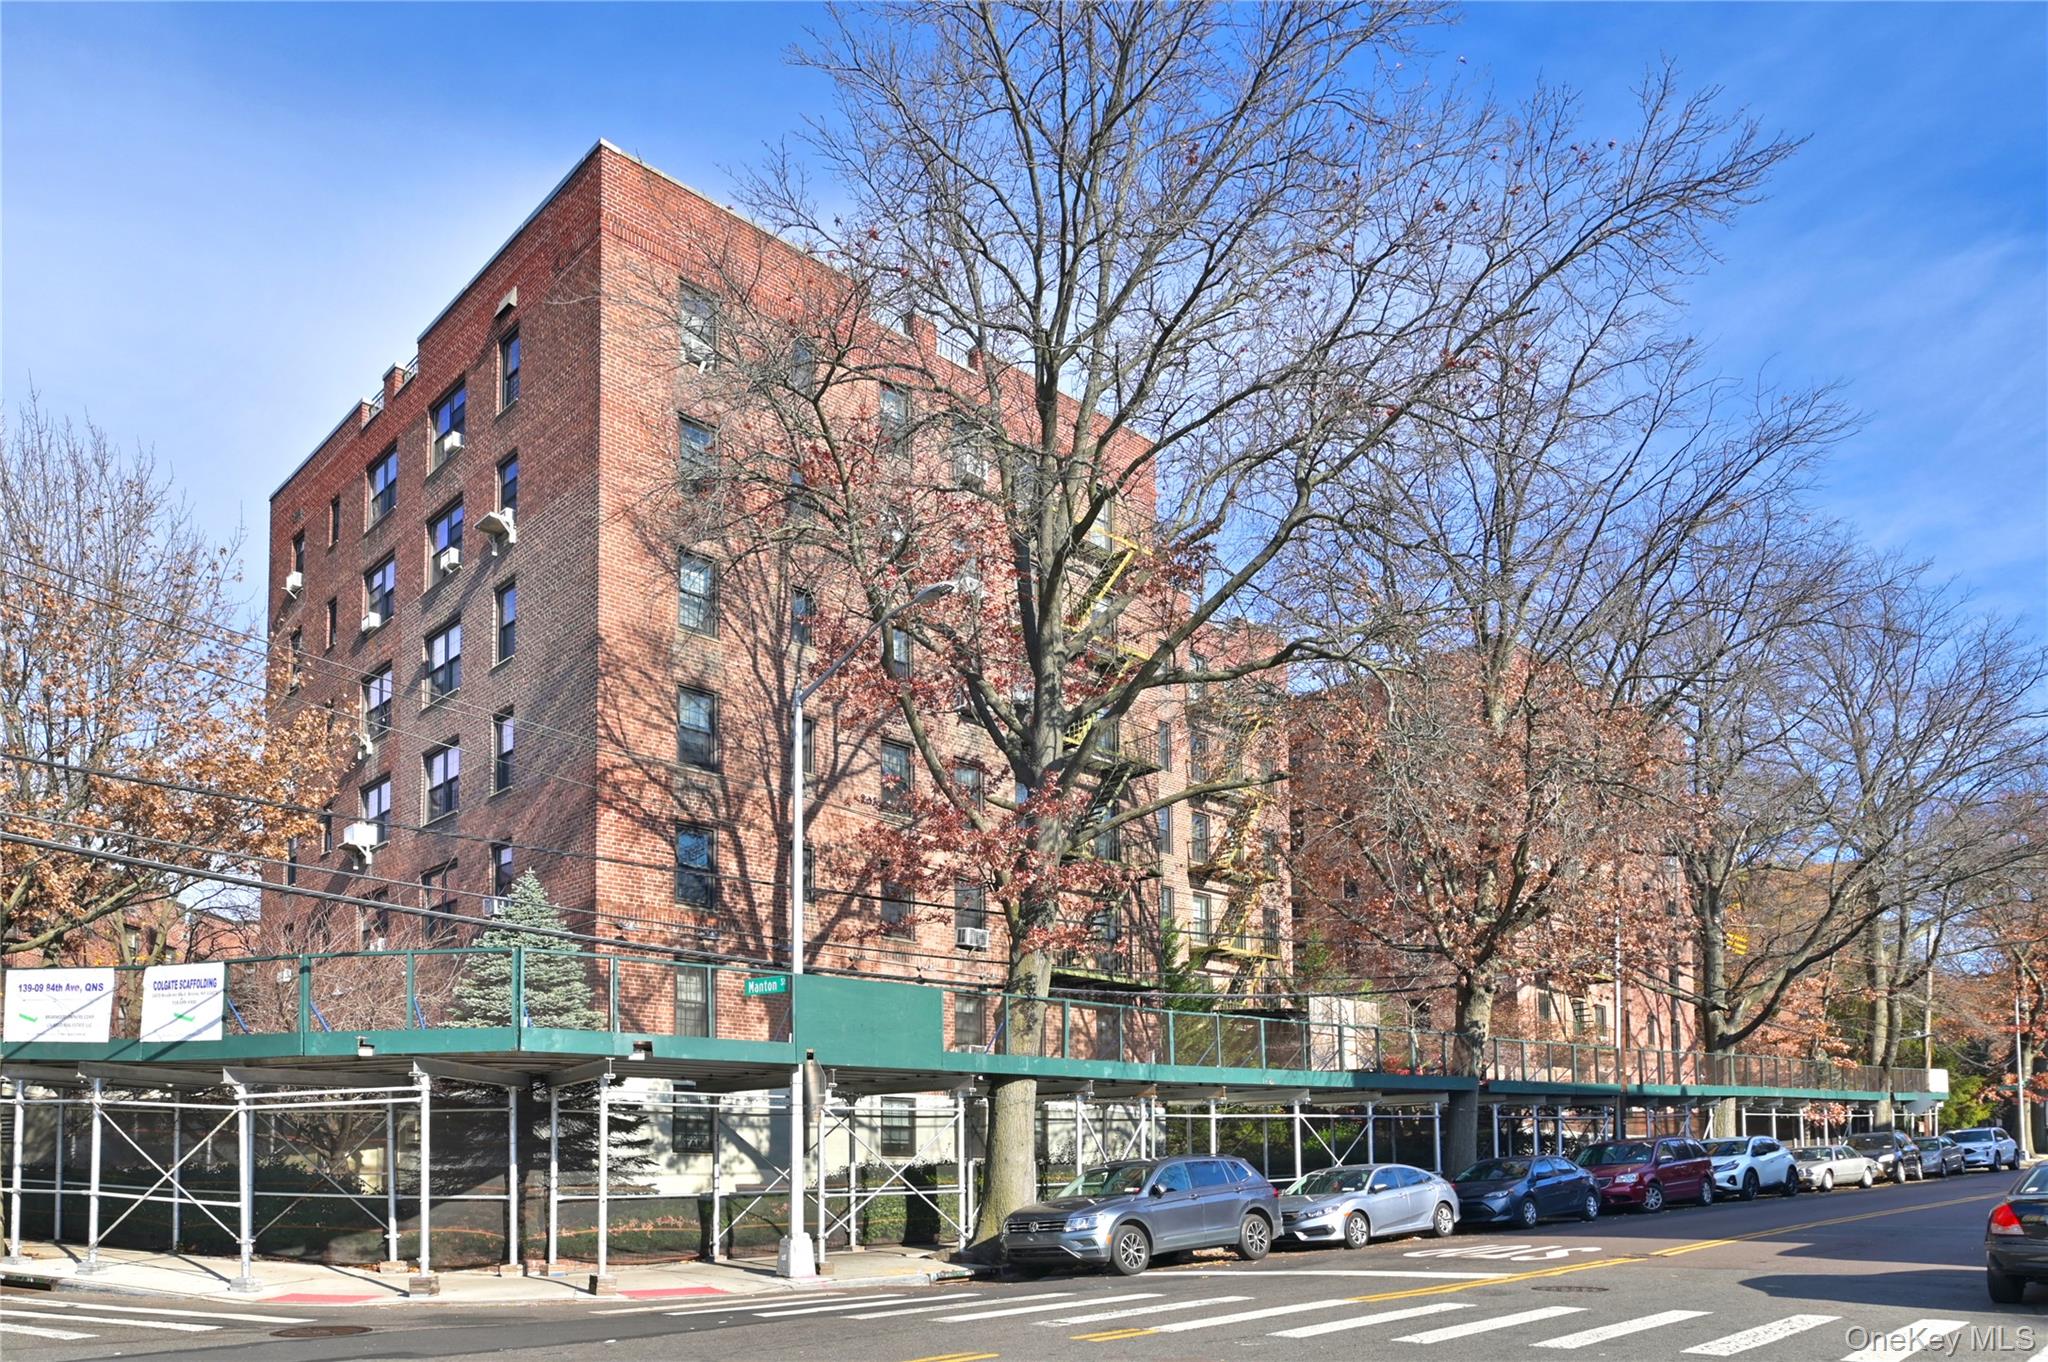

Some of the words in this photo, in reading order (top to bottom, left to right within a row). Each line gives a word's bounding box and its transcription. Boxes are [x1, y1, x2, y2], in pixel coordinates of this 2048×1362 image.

[18, 983, 44, 993] 139-09
[46, 983, 63, 992] 84th
[85, 983, 104, 992] QNS
[153, 980, 178, 991] COLGATE
[179, 978, 217, 990] SCAFFOLDING
[748, 980, 778, 993] Manton
